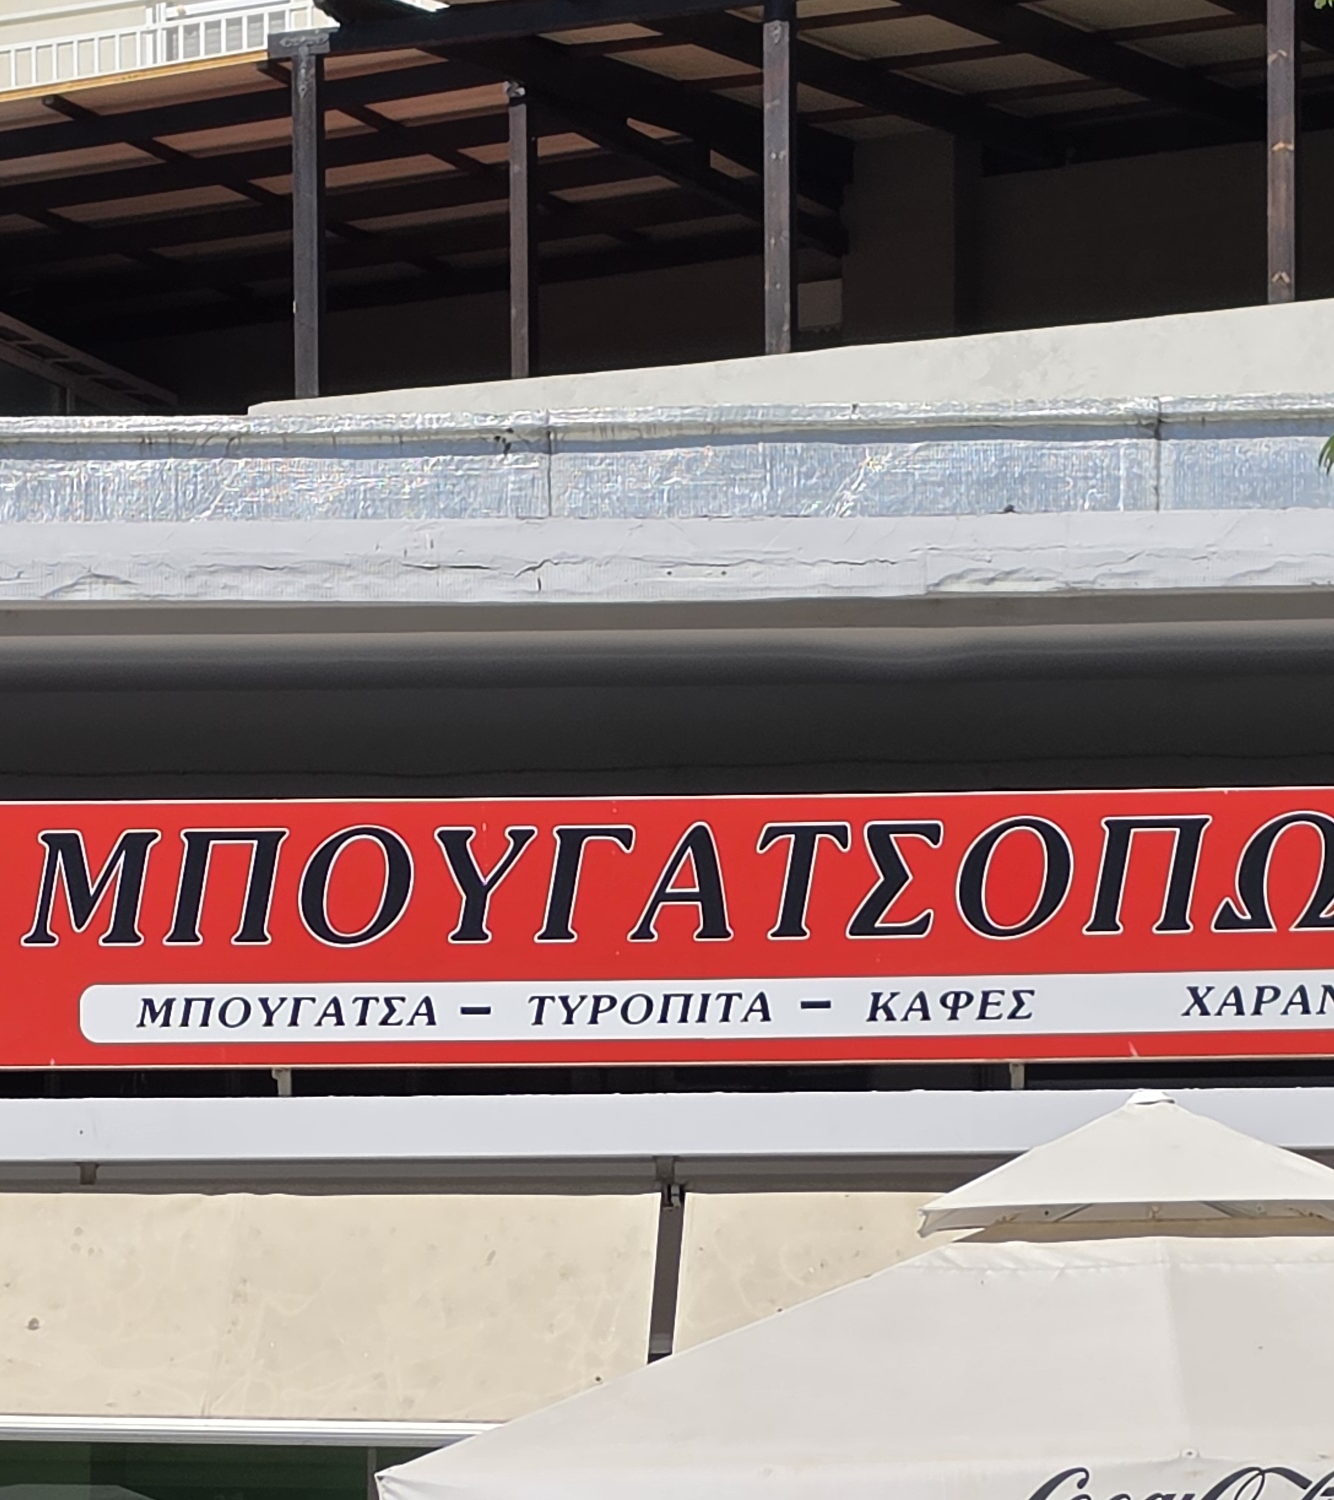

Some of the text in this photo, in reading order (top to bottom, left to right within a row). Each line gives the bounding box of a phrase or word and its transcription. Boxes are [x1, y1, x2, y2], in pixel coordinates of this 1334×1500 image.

[135, 995, 438, 1028] ΜΠΟΥΓΑΤΣΑ
[527, 991, 773, 1027] ΤΥΡΟΠΙΤΑ
[866, 988, 1036, 1023] ΚΑΦΕΣ
